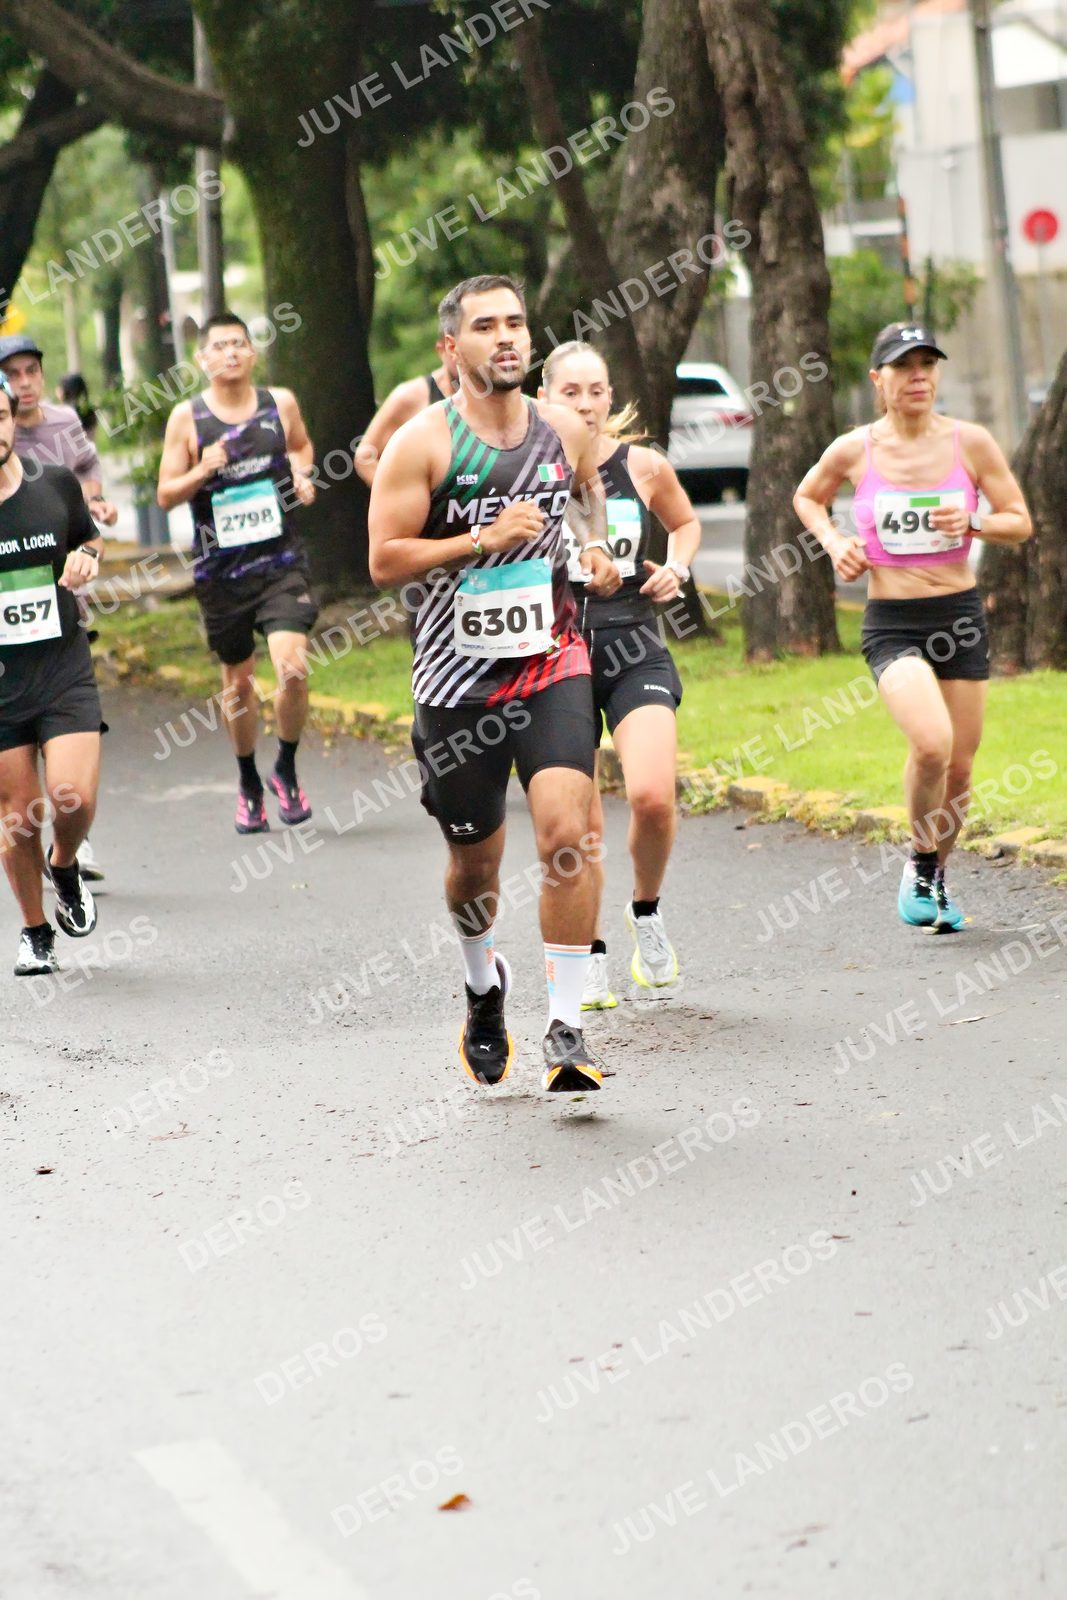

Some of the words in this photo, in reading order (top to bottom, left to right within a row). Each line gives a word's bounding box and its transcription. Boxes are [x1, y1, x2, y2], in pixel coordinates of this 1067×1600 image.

[446, 487, 570, 524] MÉXCO
[221, 508, 274, 532] 2798
[881, 510, 938, 534] 49
[22, 532, 57, 551] LOCAL
[3, 599, 52, 626] 657
[461, 603, 544, 637] 6301
